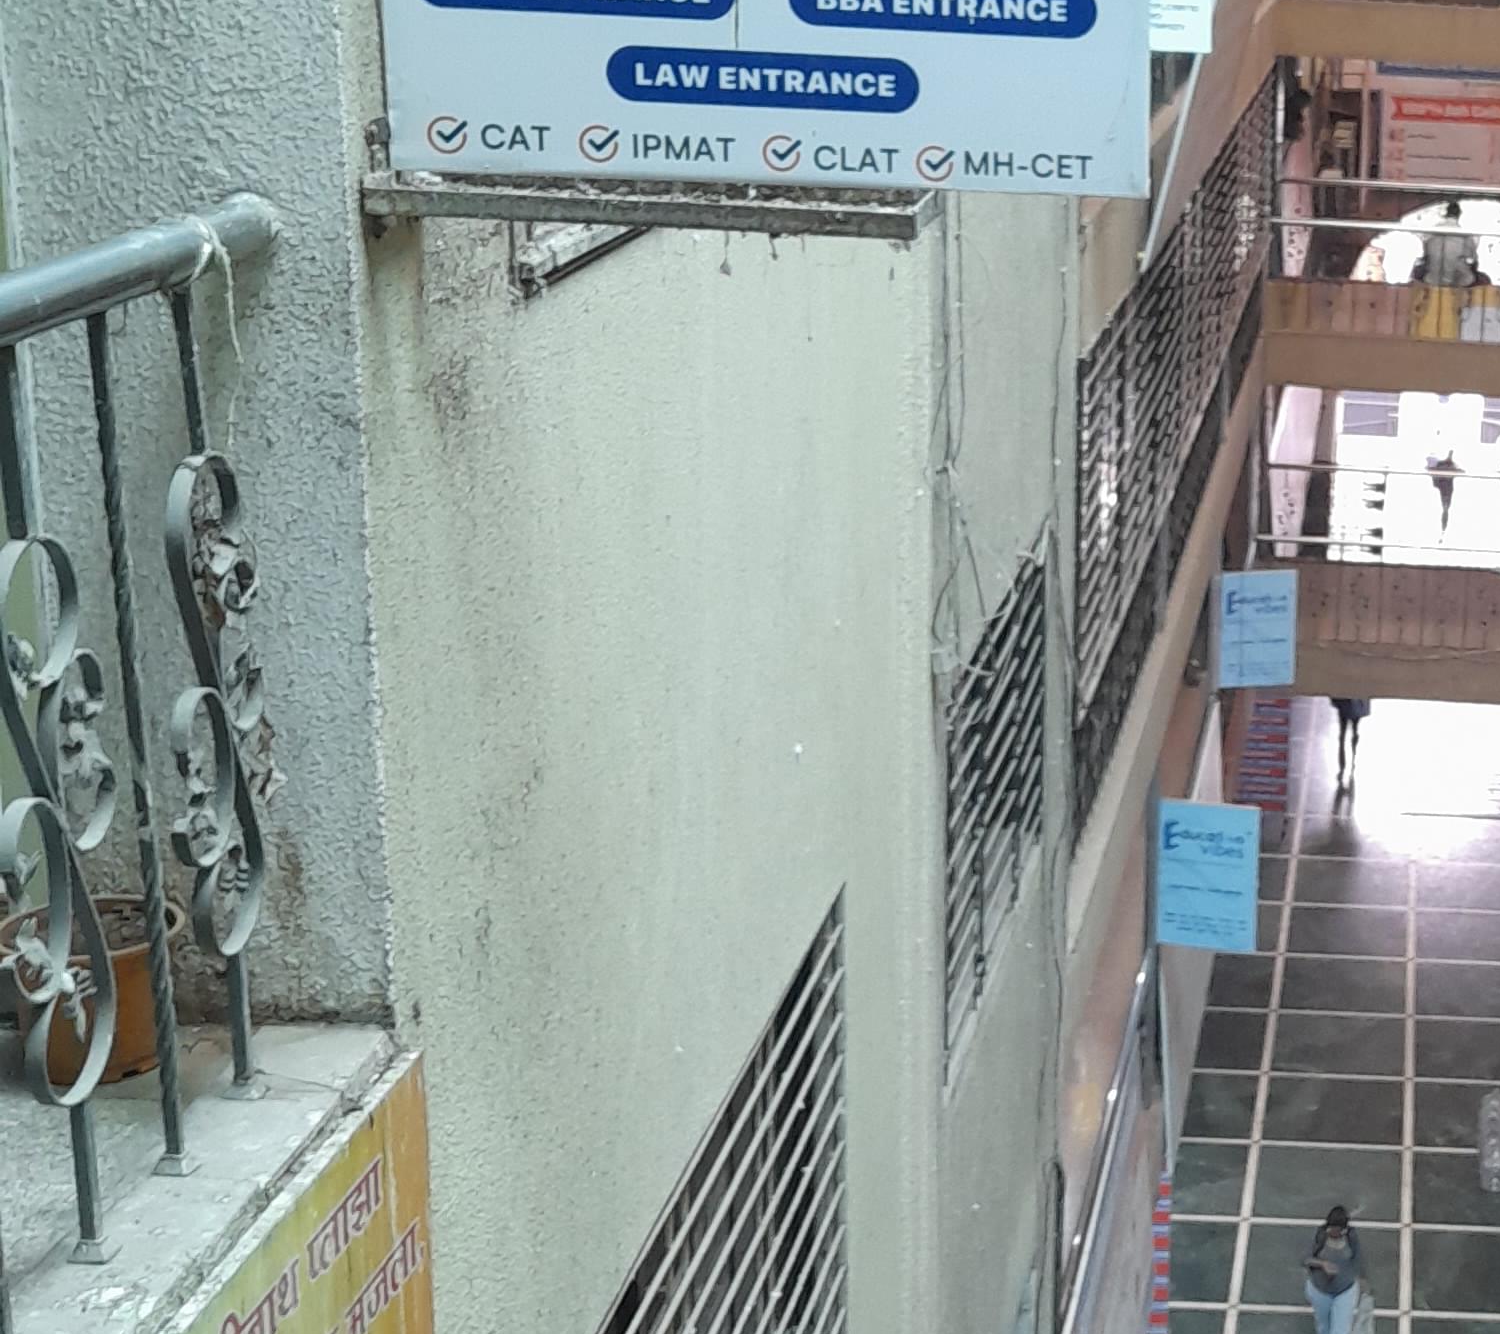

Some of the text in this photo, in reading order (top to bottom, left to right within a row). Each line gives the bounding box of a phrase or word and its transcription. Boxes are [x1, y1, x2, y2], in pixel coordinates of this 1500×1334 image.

[634, 62, 897, 98] LAW ENTRANCE
[480, 123, 1094, 181] CAT IPMAT CLAT MH-CET
